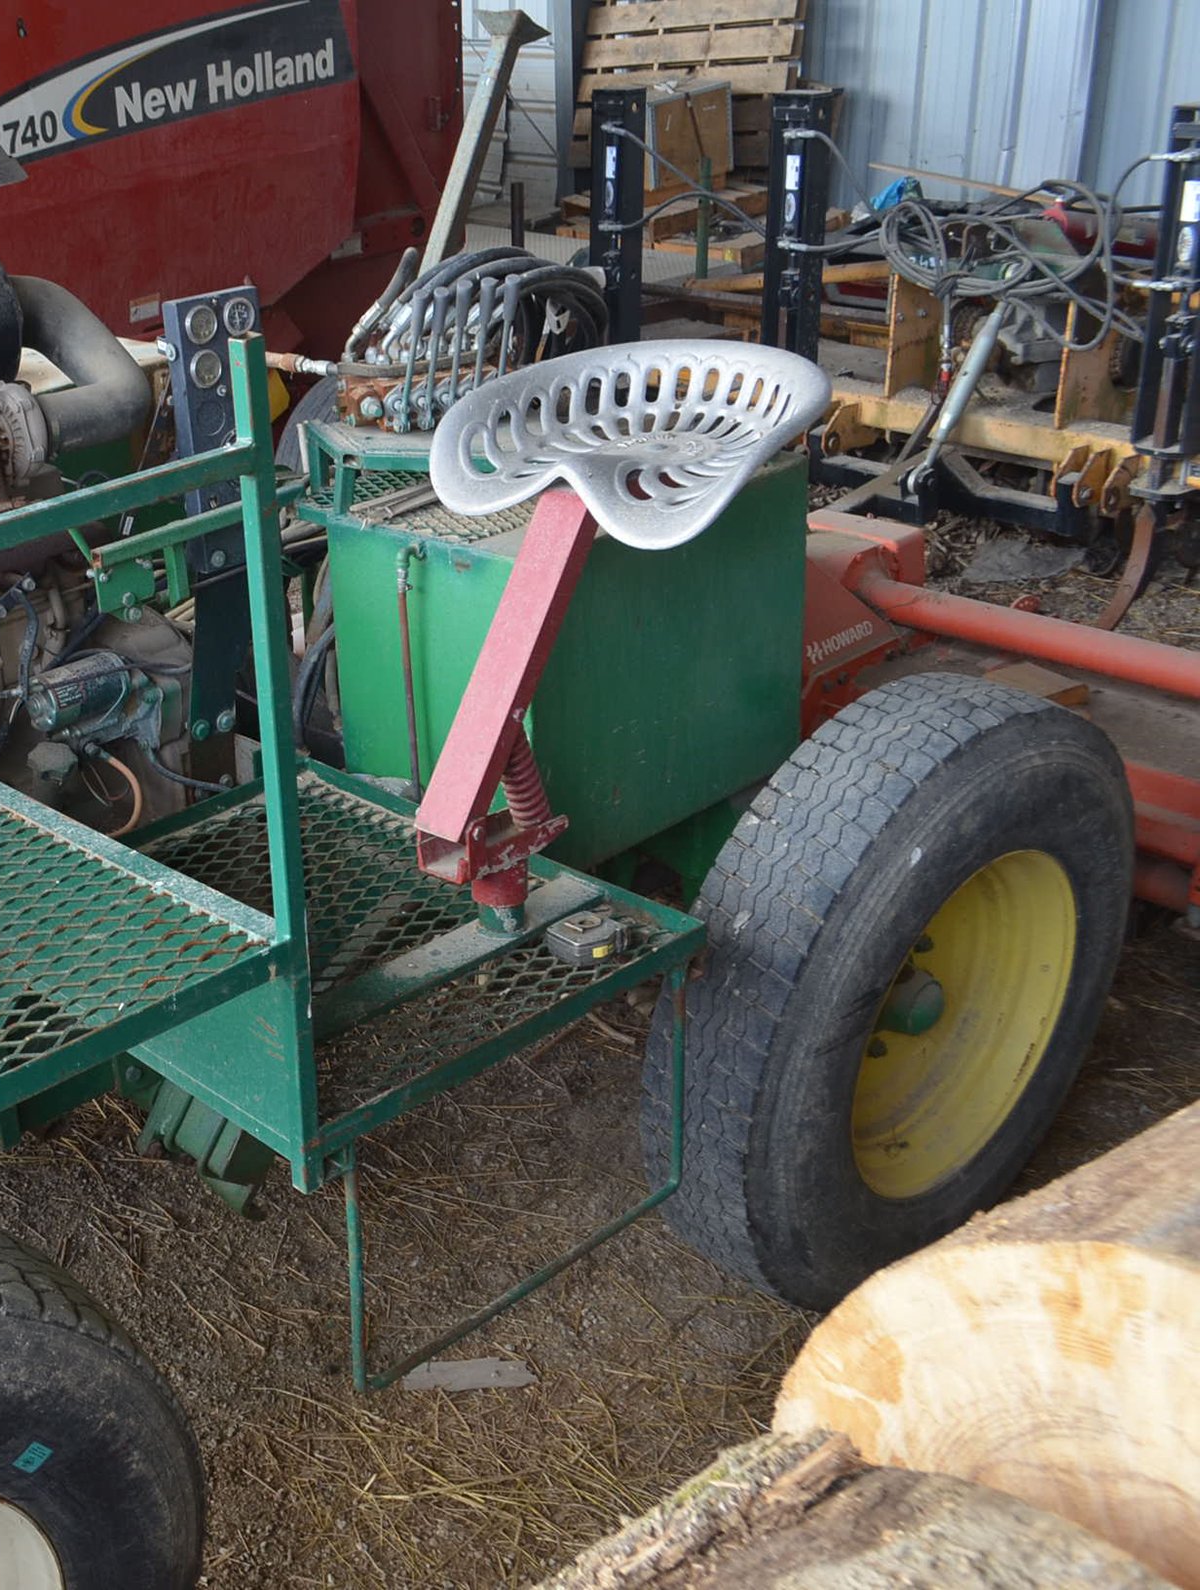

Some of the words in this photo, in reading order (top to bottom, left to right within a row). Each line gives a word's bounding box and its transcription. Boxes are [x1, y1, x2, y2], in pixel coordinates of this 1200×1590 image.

[114, 79, 197, 128] New
[206, 38, 335, 104] Holland
[821, 620, 873, 656] HOWARD
